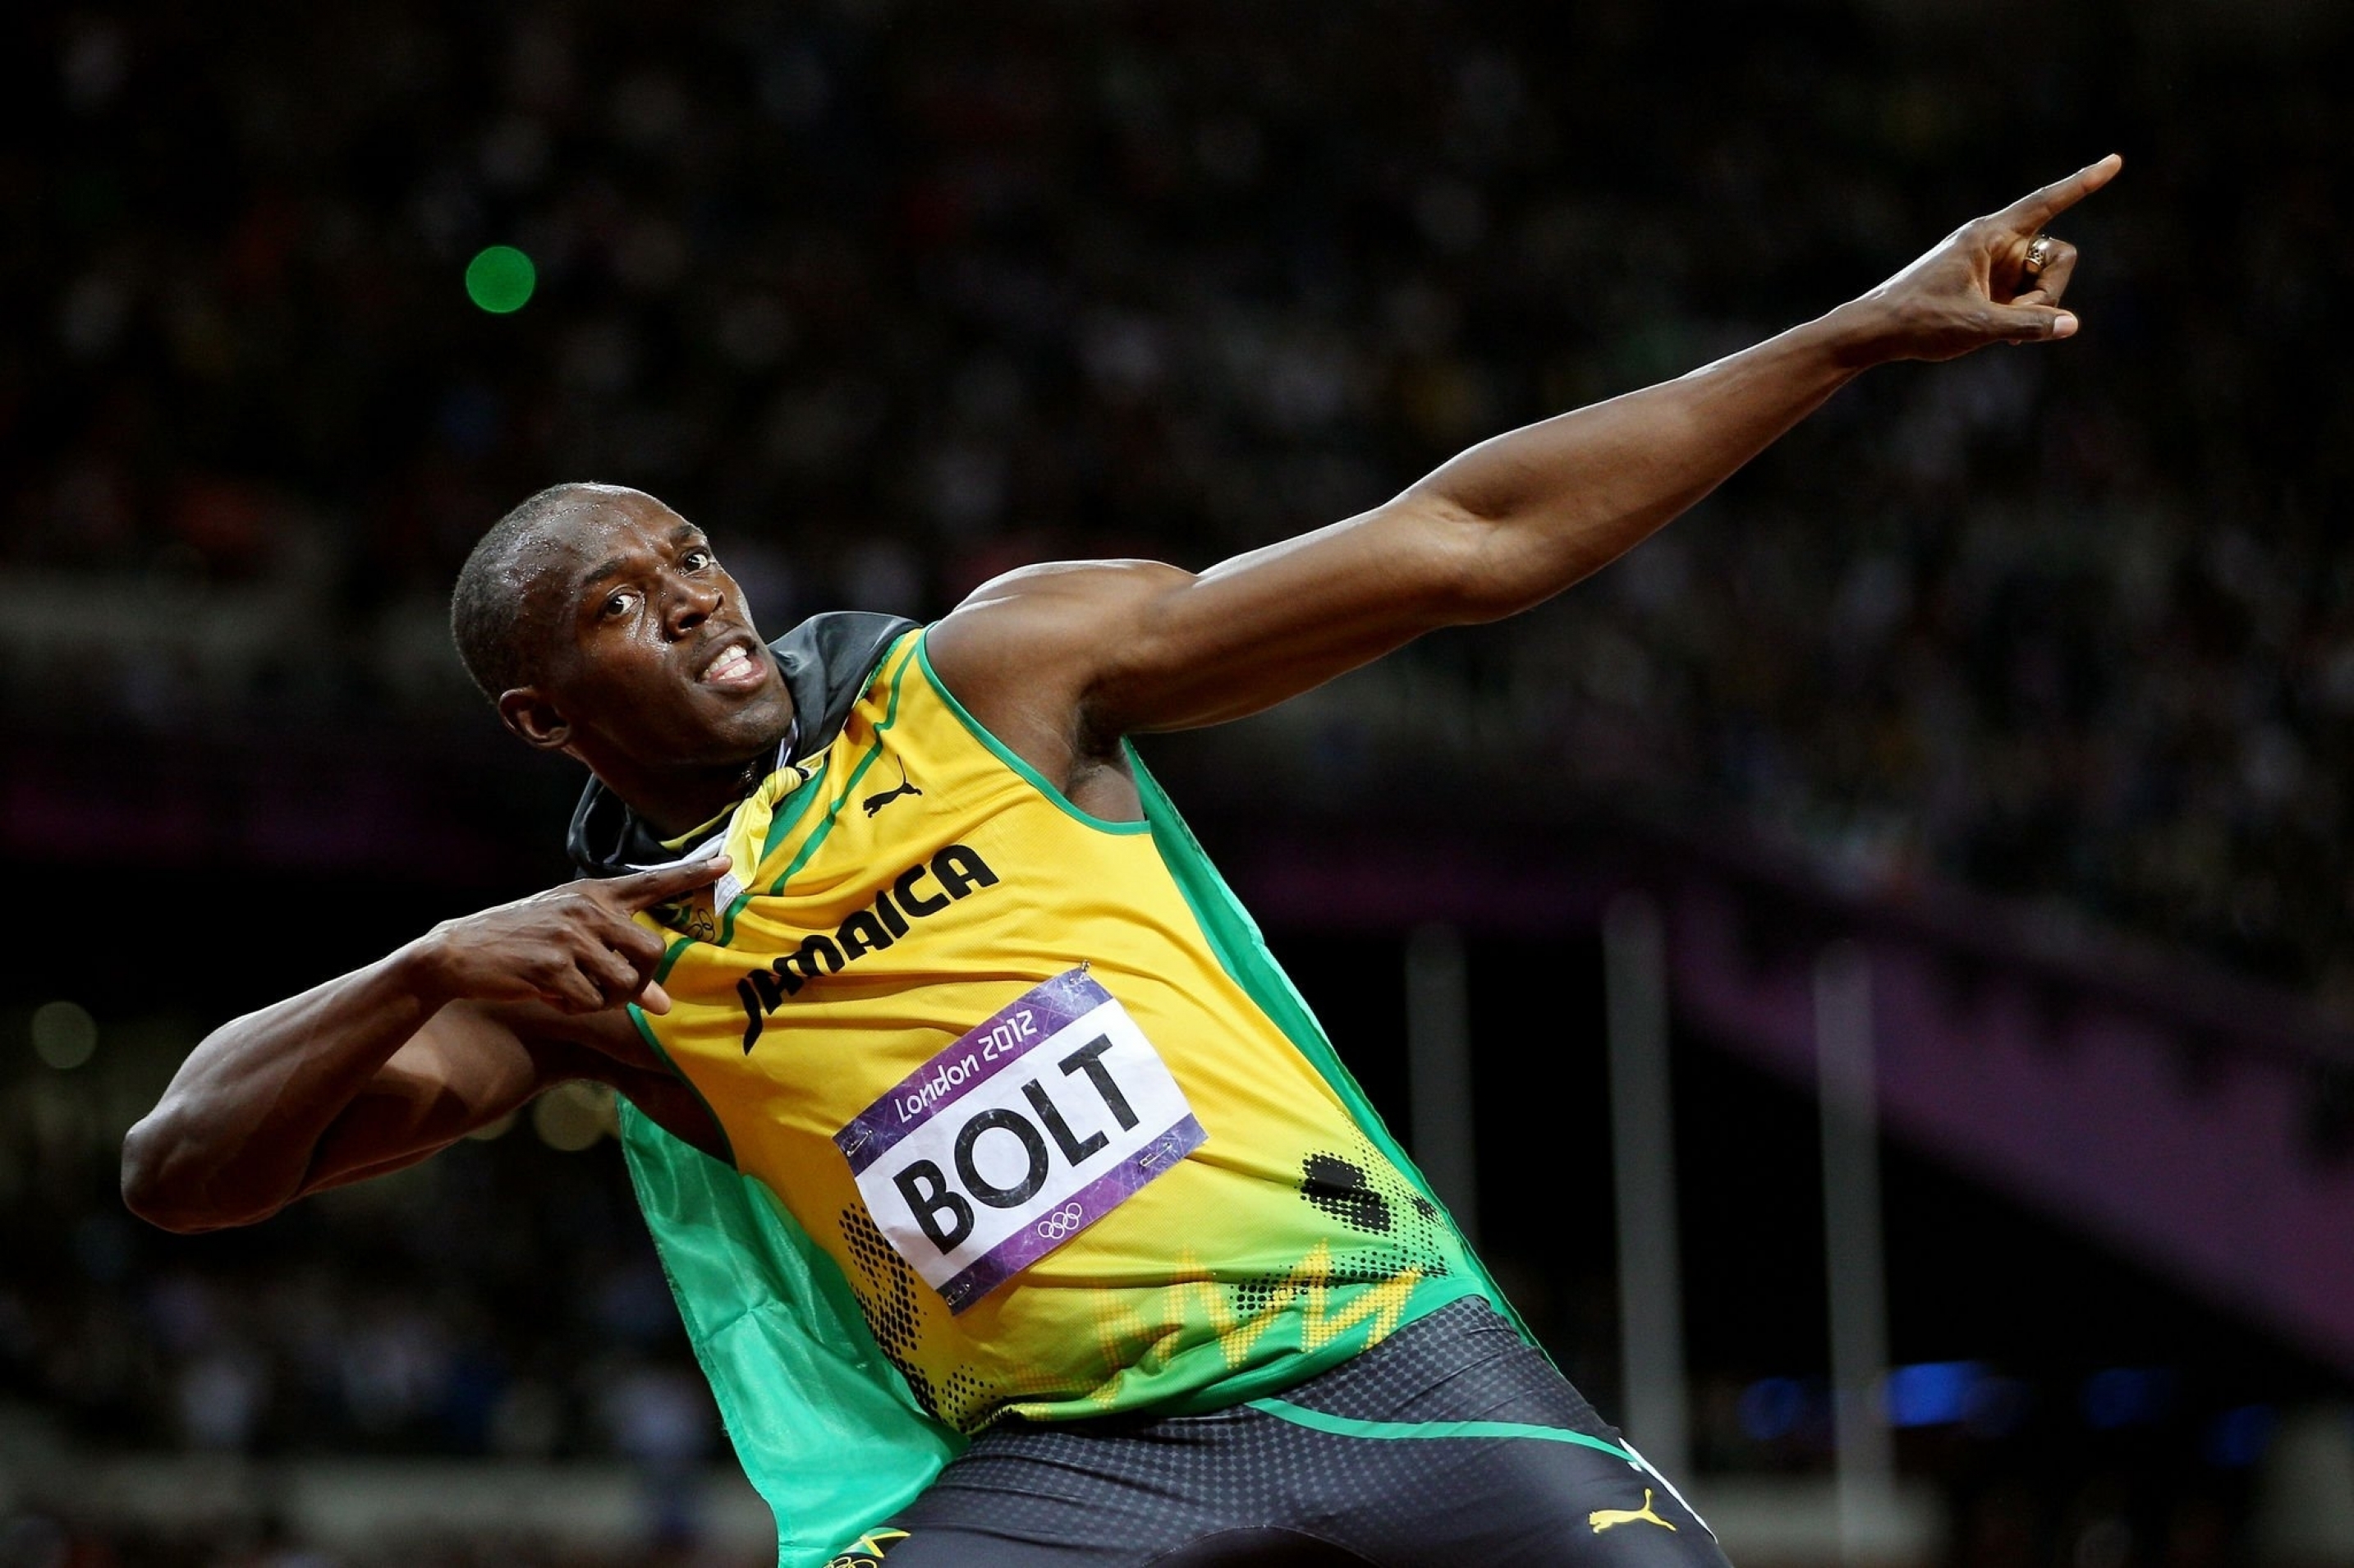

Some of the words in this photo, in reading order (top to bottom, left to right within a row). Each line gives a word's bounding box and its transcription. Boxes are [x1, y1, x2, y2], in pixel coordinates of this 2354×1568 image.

[736, 845, 999, 1056] JAMAICA
[893, 1033, 1139, 1255] BOLT
[895, 1054, 980, 1123] London
[978, 1010, 1037, 1061] 2012
